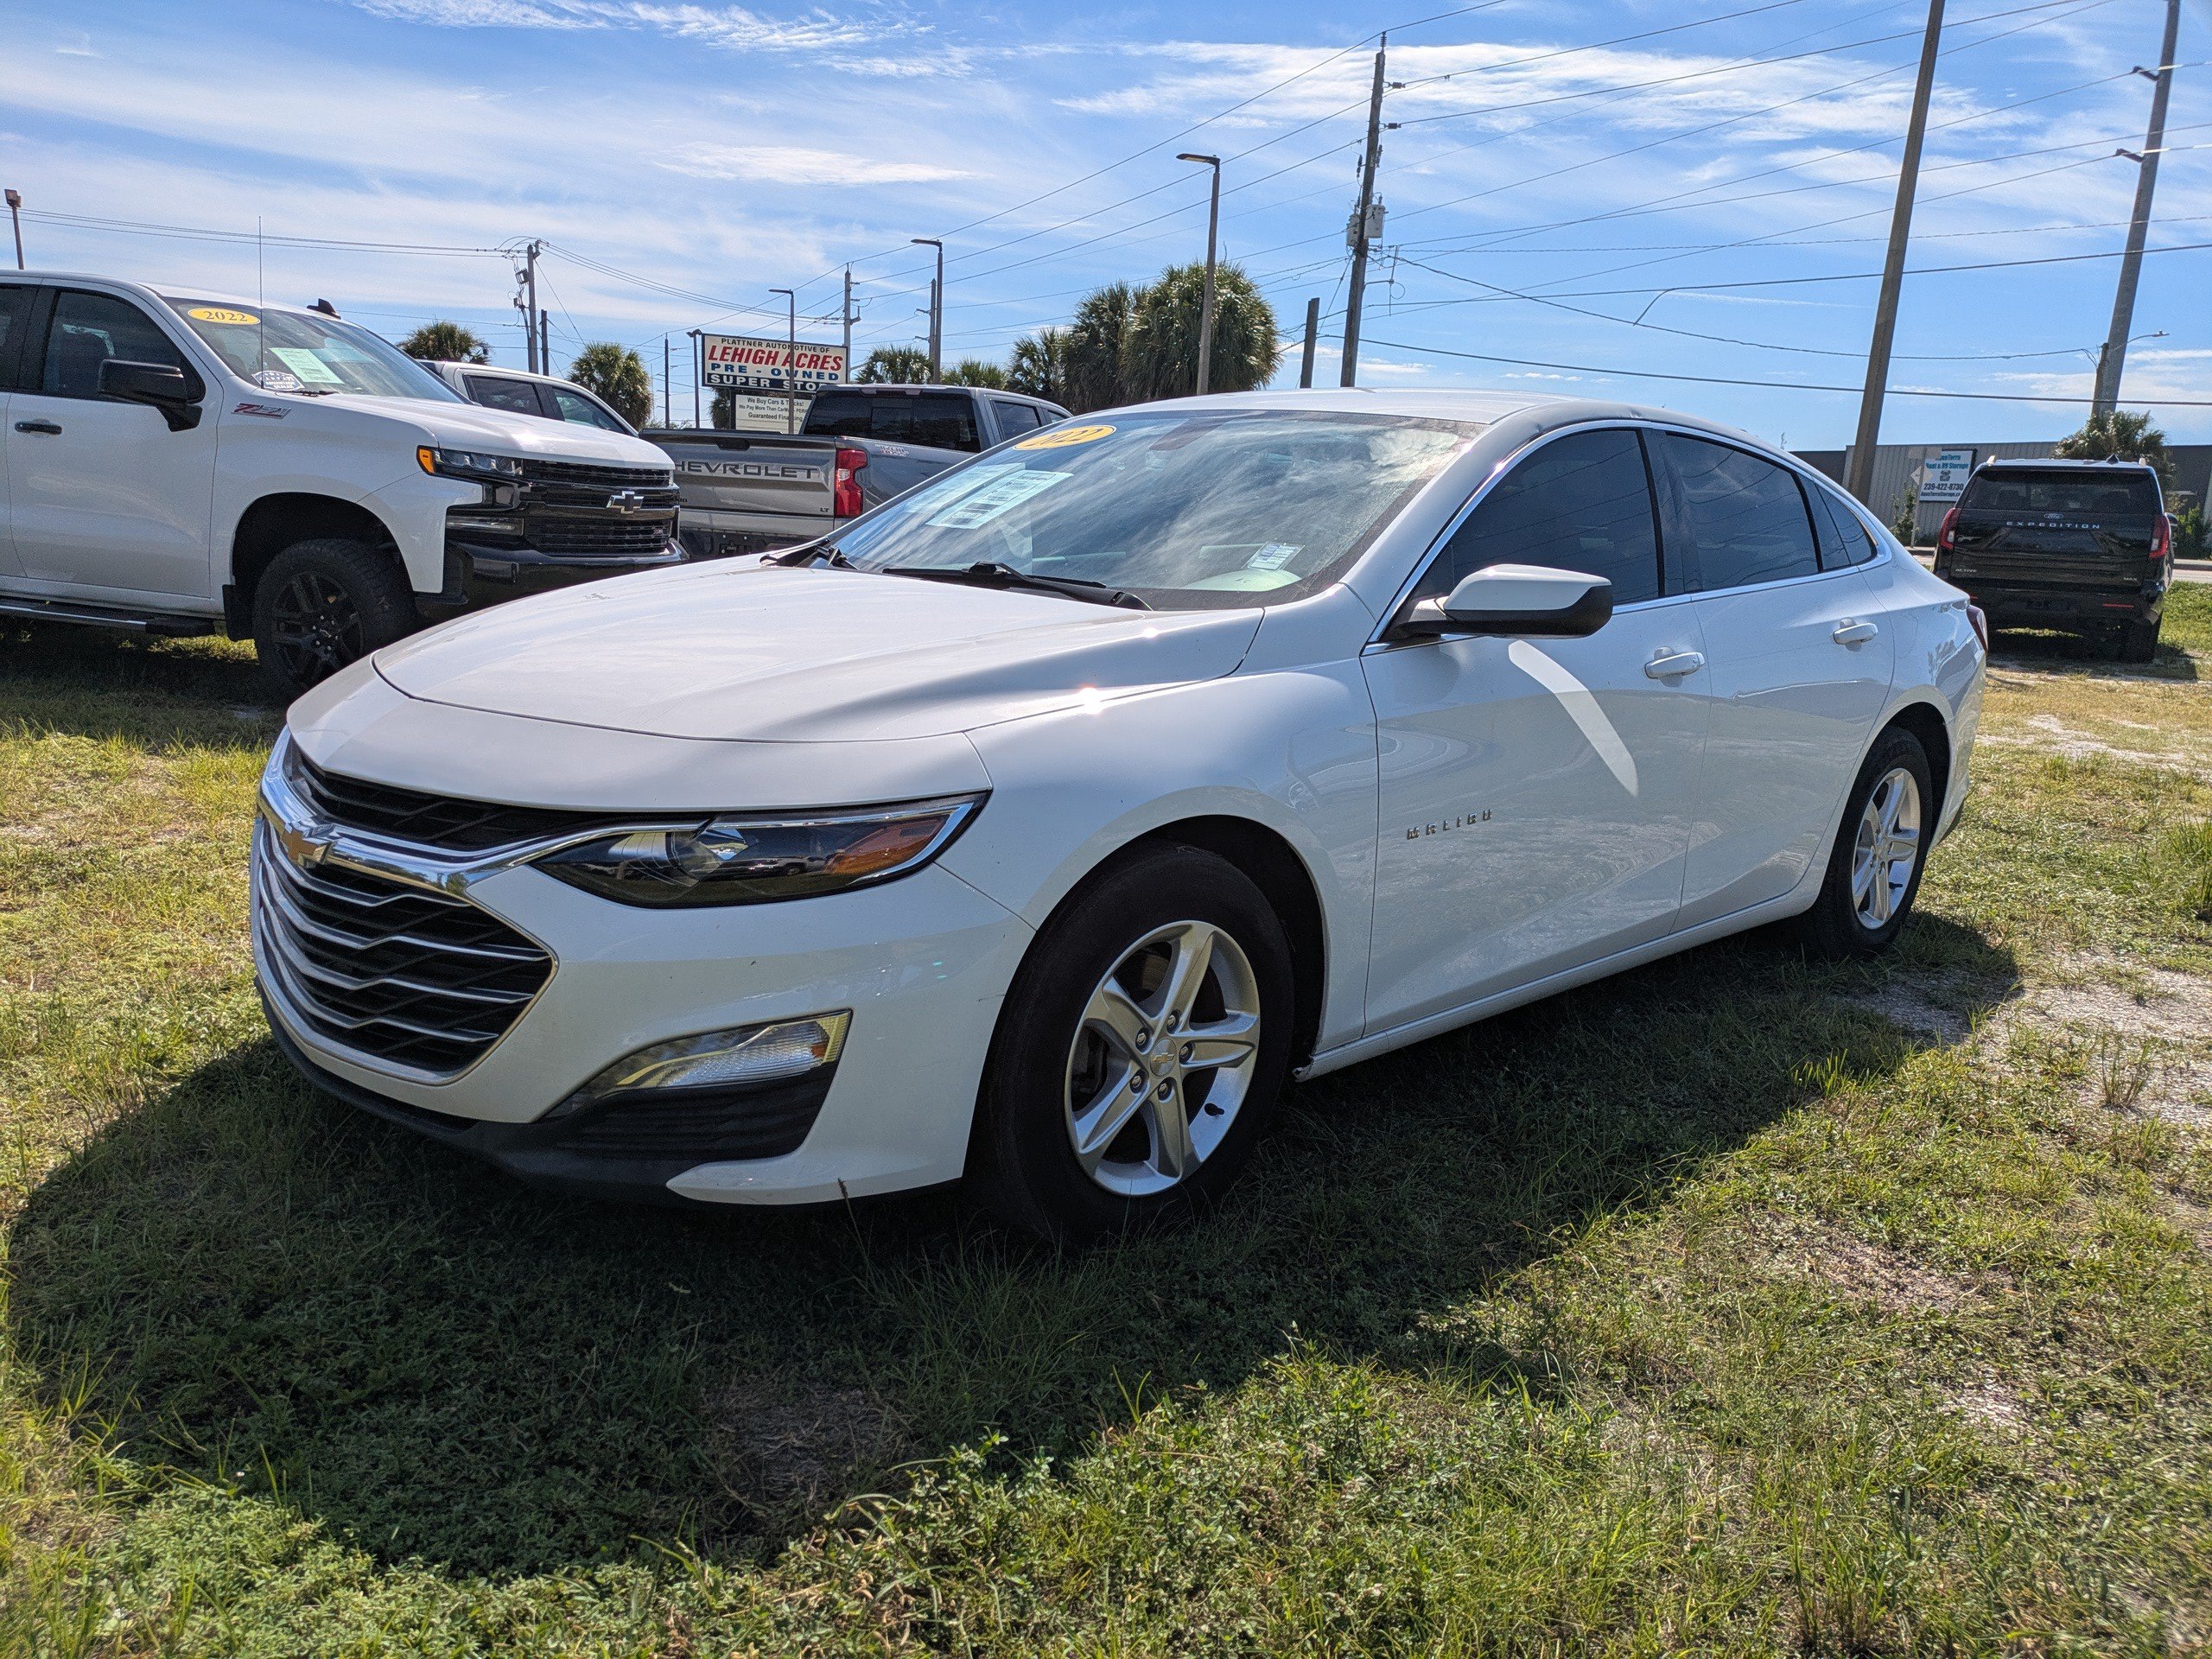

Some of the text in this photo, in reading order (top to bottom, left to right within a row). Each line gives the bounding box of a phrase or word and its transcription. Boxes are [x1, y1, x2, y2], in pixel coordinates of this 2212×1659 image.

[204, 311, 248, 321] 2022
[721, 338, 763, 347] PLATTNER
[708, 345, 843, 372] LEHIGH ACRES
[710, 374, 770, 388] SUPER
[711, 363, 747, 374] PRE
[771, 367, 839, 381] OWNED
[675, 461, 819, 480] HEVROLET
[1407, 809, 1492, 840] MALIBU
